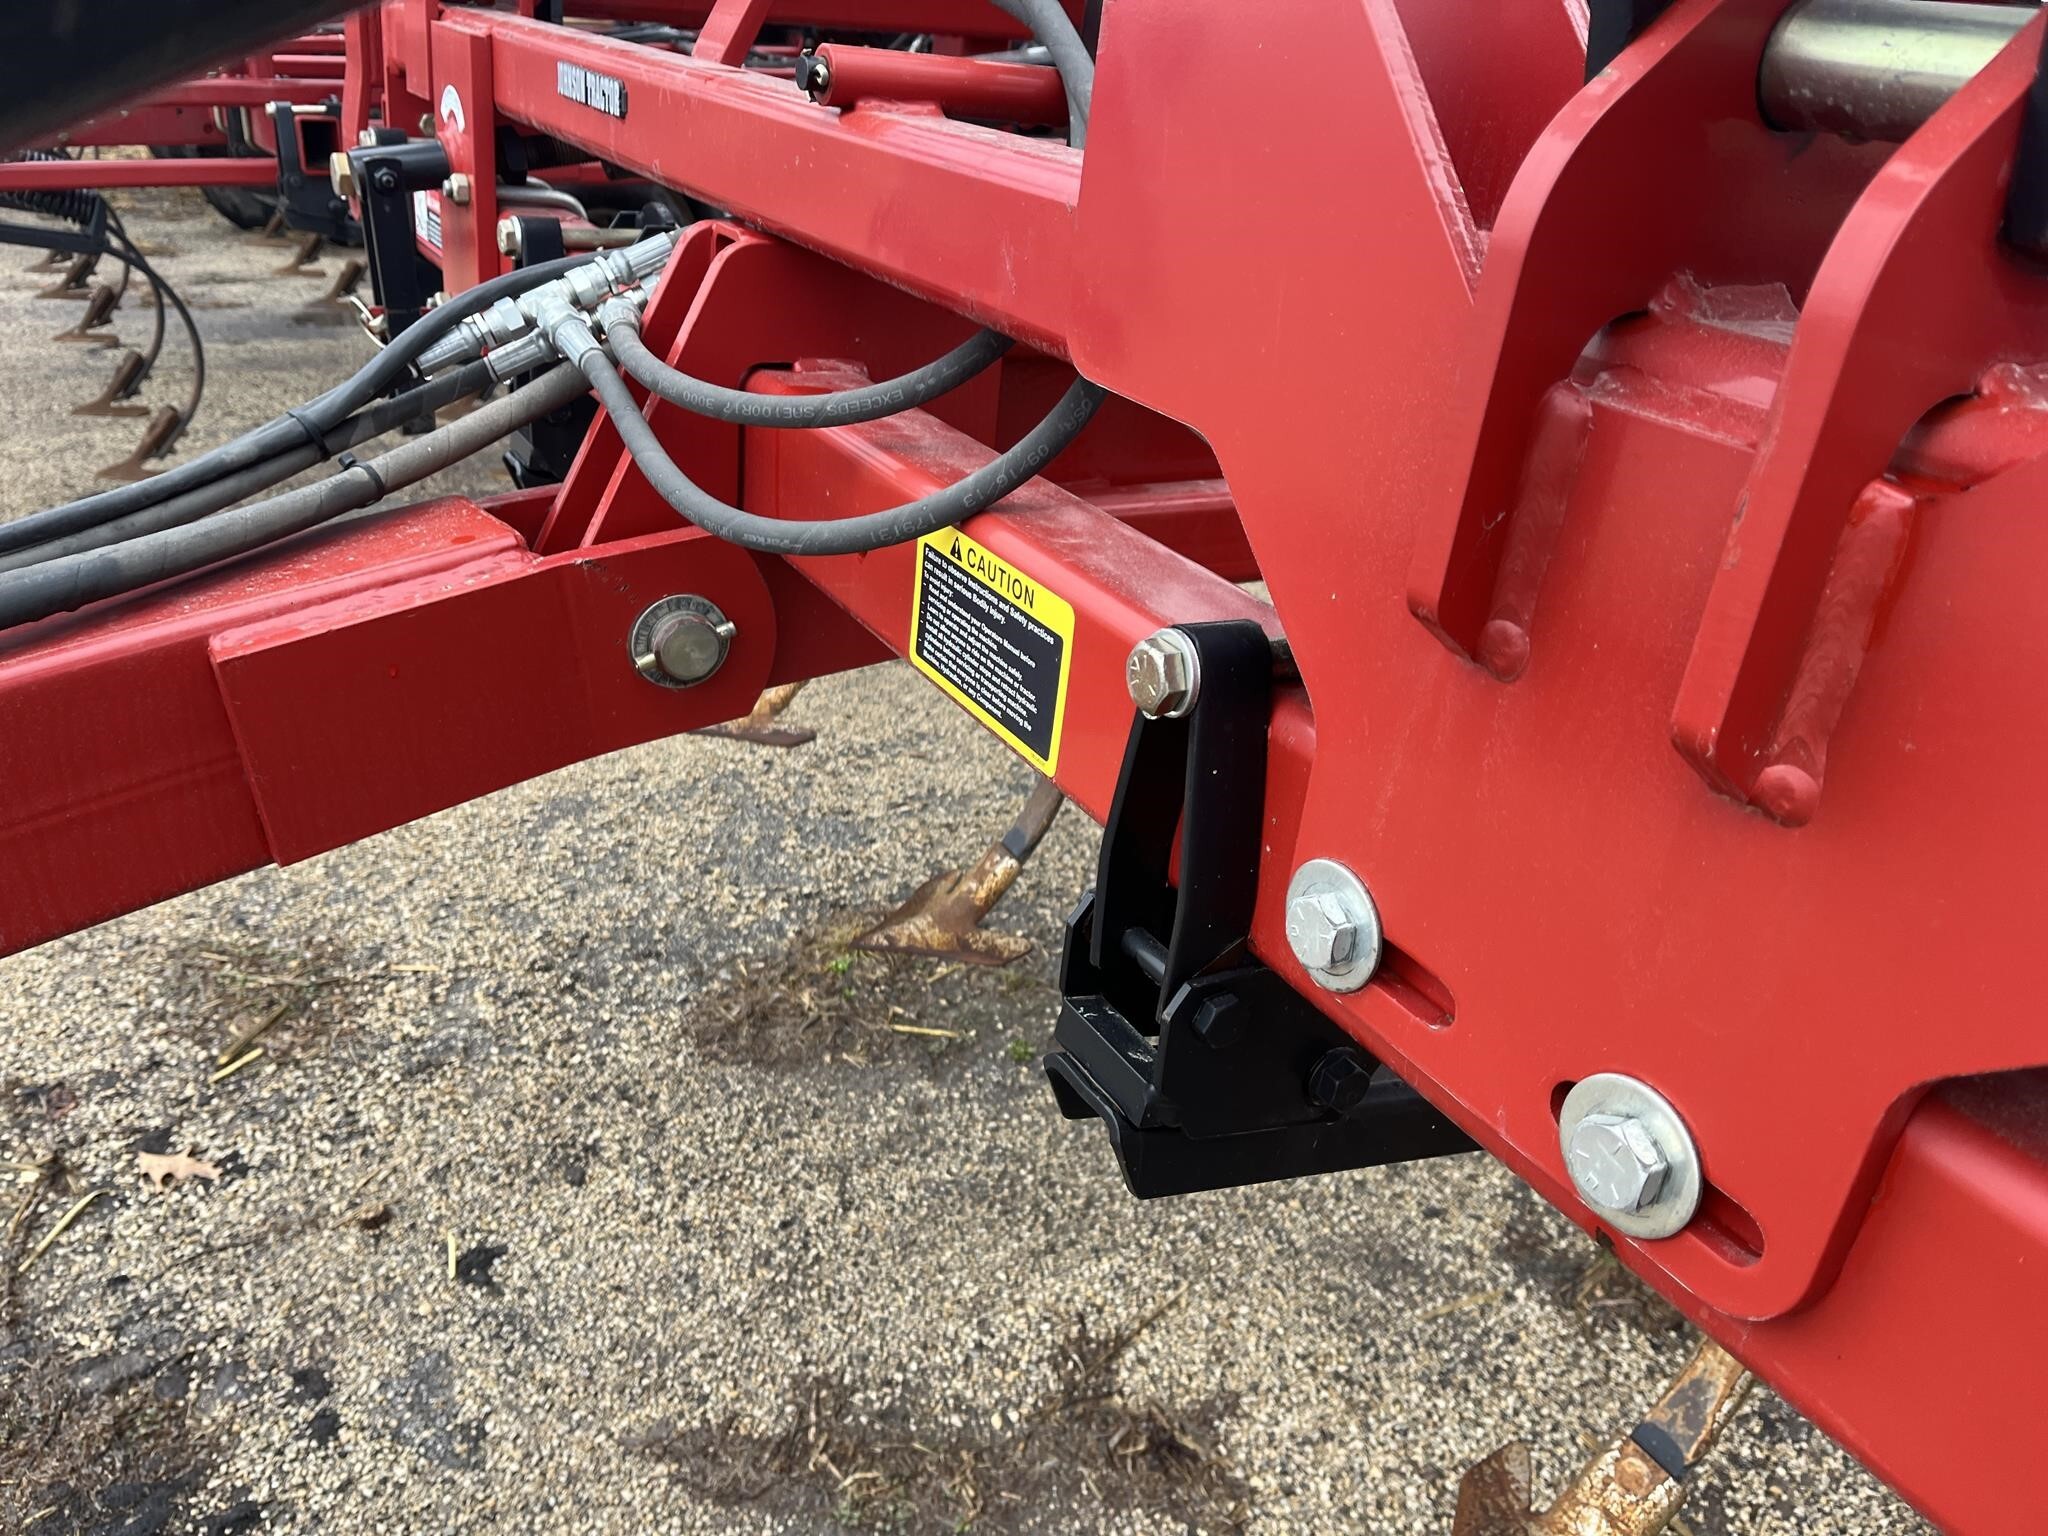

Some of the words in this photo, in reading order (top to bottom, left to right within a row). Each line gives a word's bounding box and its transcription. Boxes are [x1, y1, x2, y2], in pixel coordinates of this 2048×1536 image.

[586, 71, 620, 117] TRACTOR
[682, 390, 715, 410] 3000
[826, 388, 904, 416] EXCEEDS
[740, 533, 790, 548] Parker
[925, 547, 941, 564] Failure
[947, 565, 967, 583] observe
[1009, 606, 1027, 627] Safety
[1027, 621, 1053, 644] practices
[928, 575, 940, 587] avoid
[933, 567, 947, 581] result
[953, 581, 971, 599] serious
[972, 592, 989, 612] Bodily
[967, 547, 1035, 609] CAUTION
[927, 594, 946, 613] servicing
[951, 612, 971, 632] operating
[927, 602, 938, 616] Learn
[988, 651, 1007, 669] machine
[928, 583, 939, 596] Read
[947, 599, 970, 619] understand
[970, 616, 981, 627] your
[1002, 638, 1020, 656] Manual
[1019, 651, 1035, 668] before
[939, 623, 950, 635] allow
[950, 632, 966, 647] anyone
[970, 647, 980, 658] ride
[994, 666, 1013, 684] machine
[942, 644, 955, 660] before
[955, 656, 975, 676] servicing
[942, 634, 961, 654] hydraulic
[961, 651, 979, 667] cylinder
[978, 664, 991, 677] stops
[1000, 681, 1015, 697] retract
[1015, 691, 1037, 713] hydraulic
[923, 639, 934, 652] Make
[934, 649, 948, 663] certain
[948, 659, 956, 671] that
[956, 667, 975, 686] everyone
[980, 686, 991, 698] clear
[991, 694, 1006, 710] before
[1005, 707, 1023, 726] moving
